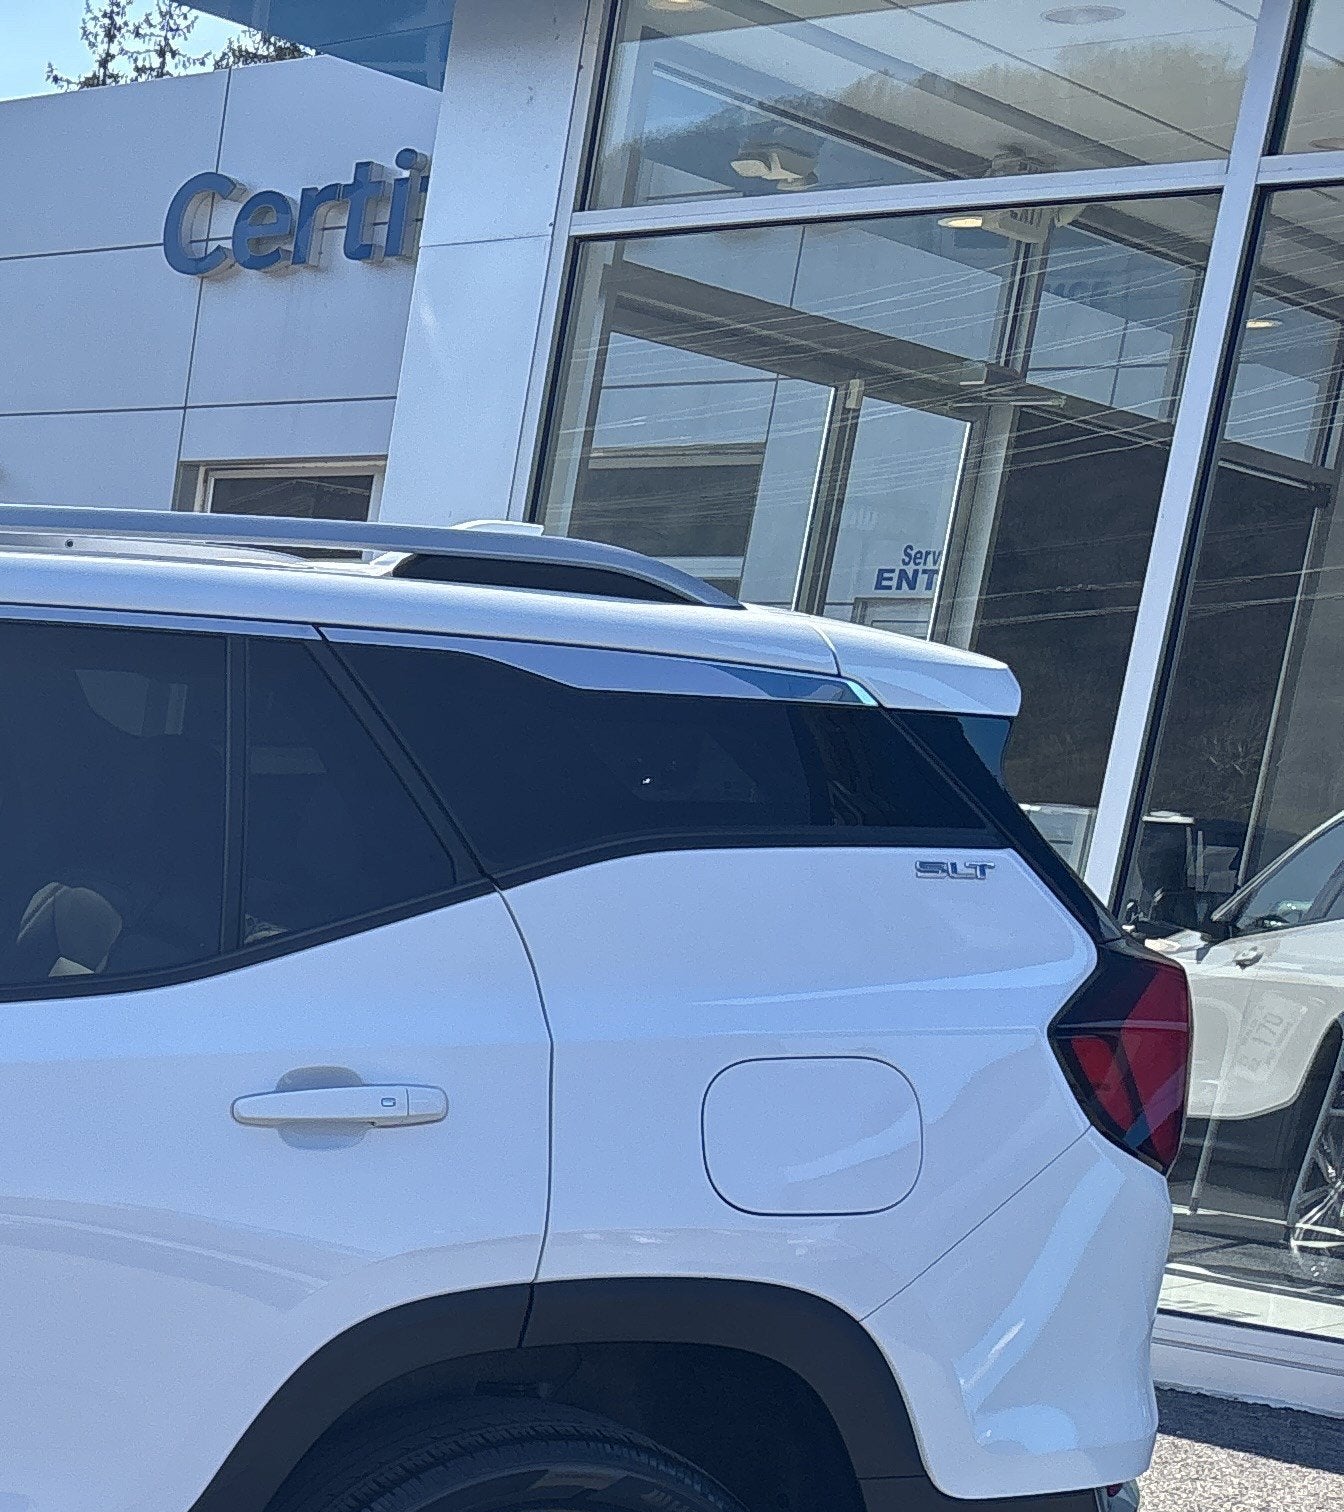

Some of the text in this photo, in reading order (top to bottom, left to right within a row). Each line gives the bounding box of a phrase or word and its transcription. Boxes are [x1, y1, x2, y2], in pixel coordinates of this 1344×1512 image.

[163, 147, 429, 275] Certi
[874, 568, 939, 591] ENT
[915, 861, 996, 880] SLT
